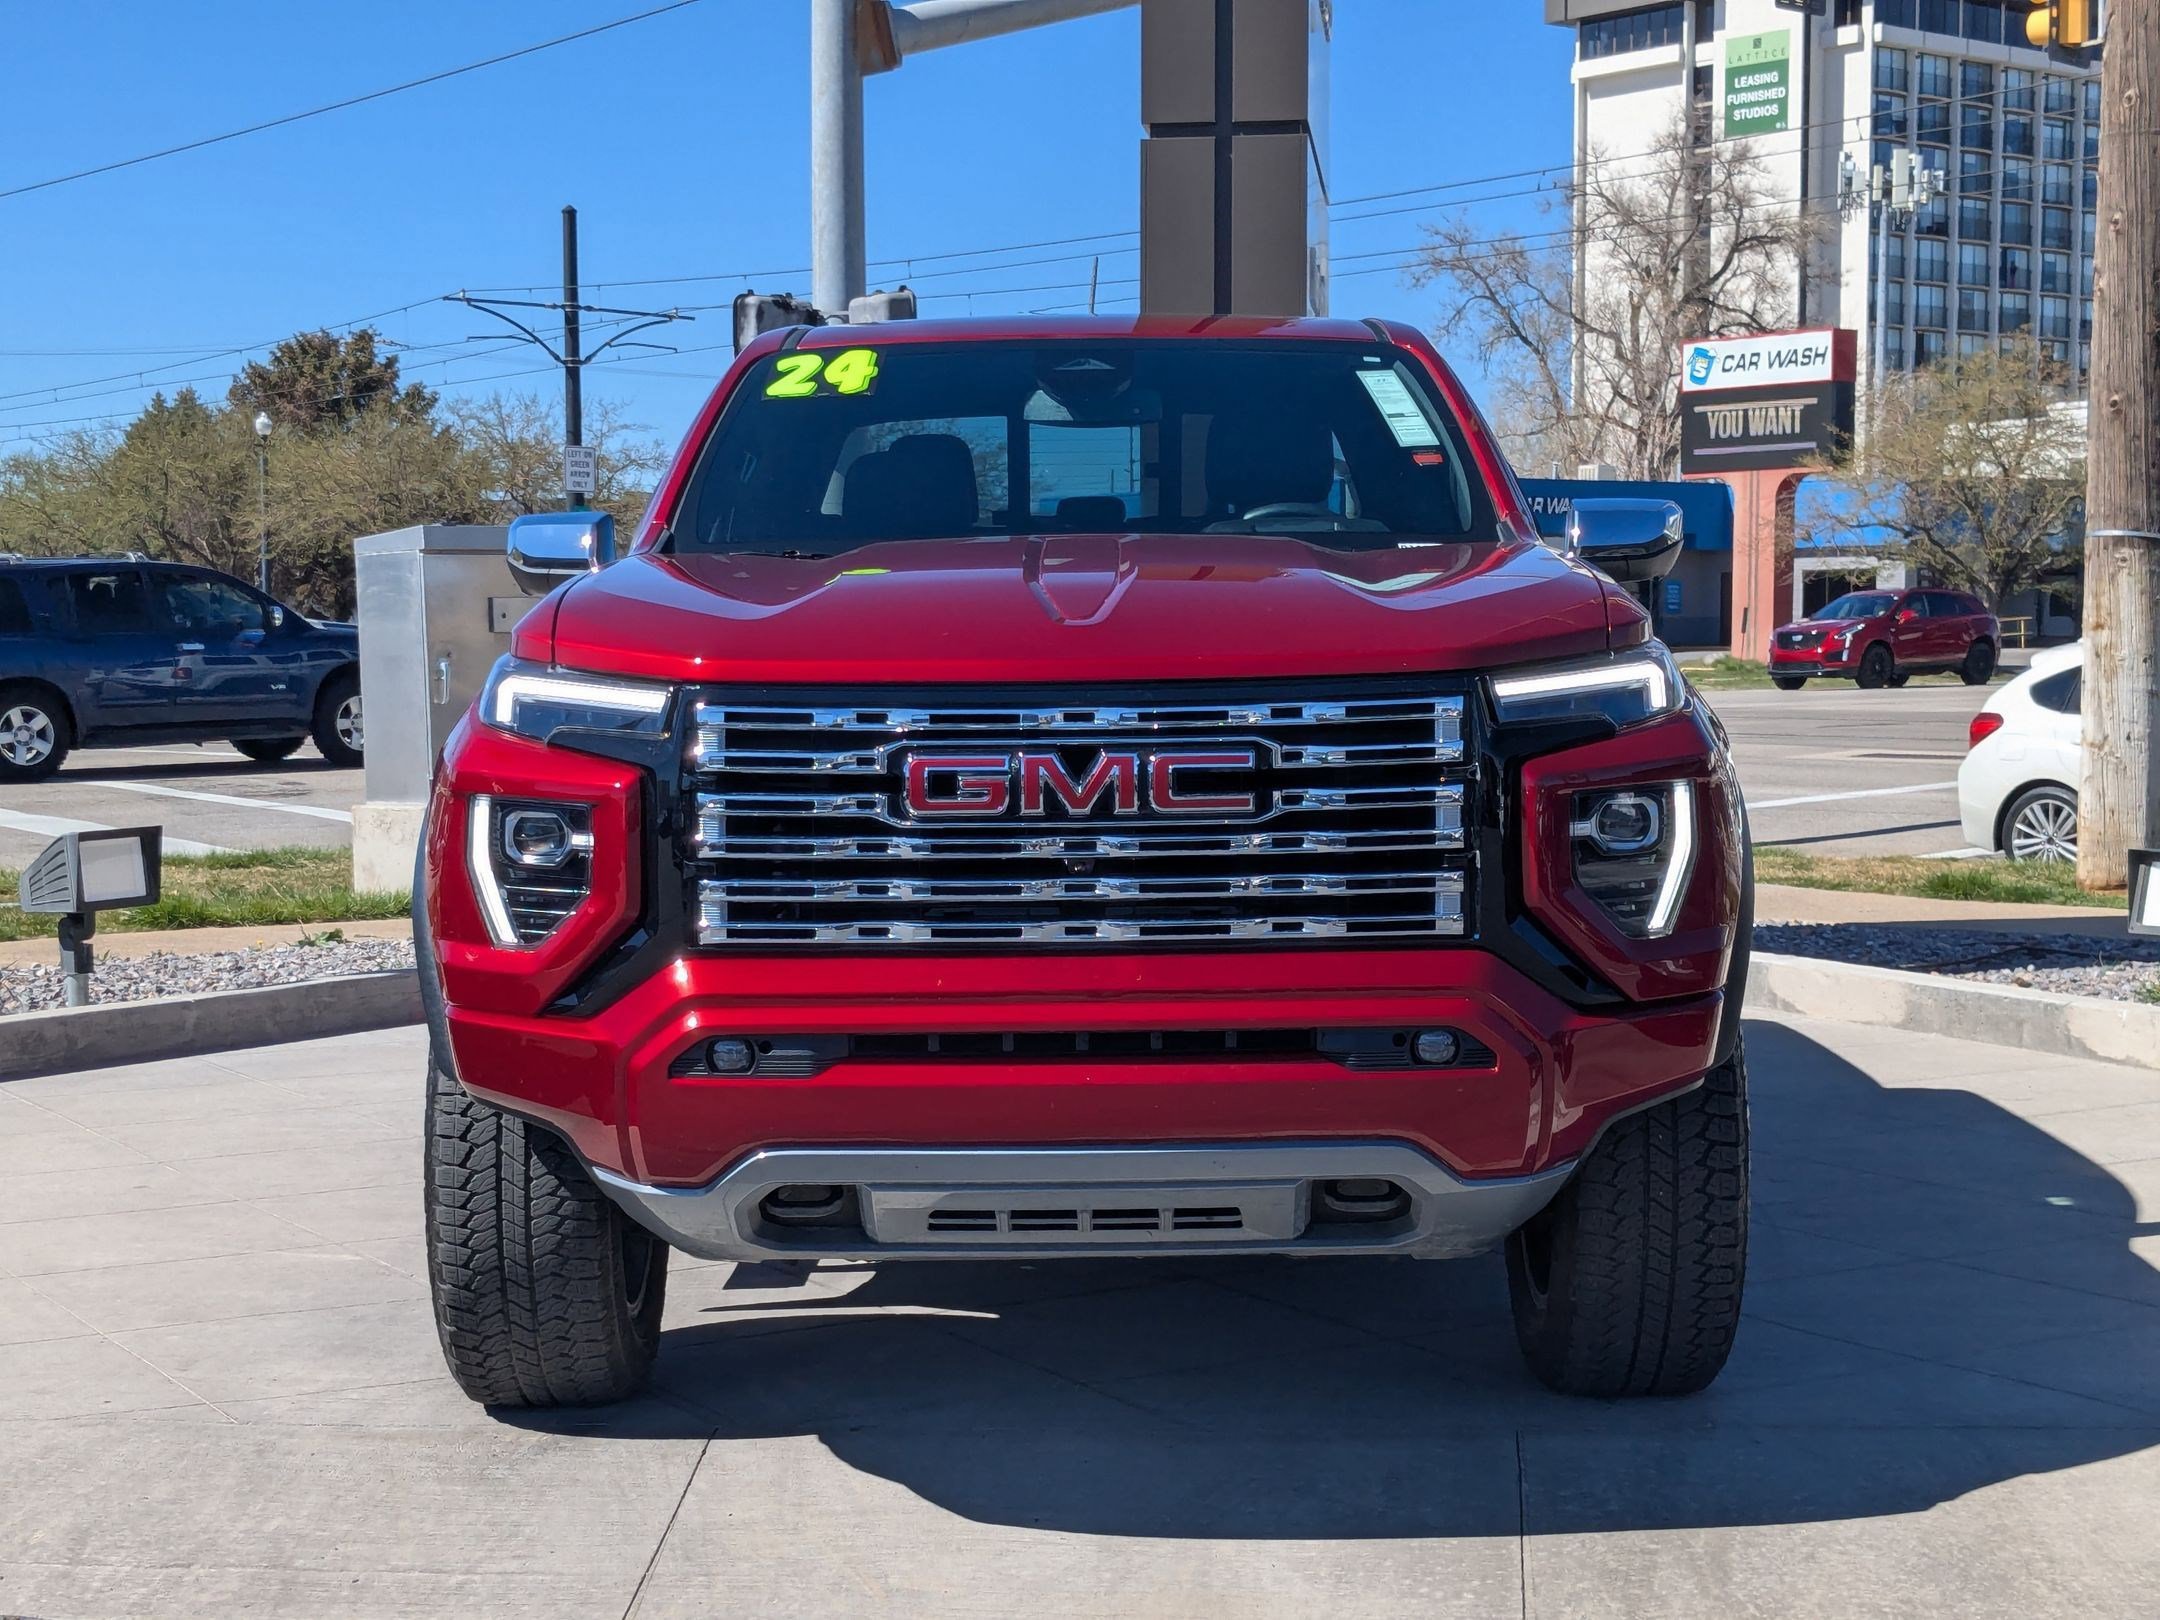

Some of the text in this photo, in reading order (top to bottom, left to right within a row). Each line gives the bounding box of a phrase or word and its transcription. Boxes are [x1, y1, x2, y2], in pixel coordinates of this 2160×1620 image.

[1728, 47, 1786, 64] LATTICE
[1734, 71, 1779, 88] LEASING
[1727, 87, 1786, 106] FURNISHED
[1732, 104, 1779, 121] STUDIOS
[1721, 345, 1829, 373] CAR WASH
[766, 349, 879, 398] 24
[1707, 404, 1805, 440] YOU WANT
[567, 450, 581, 458] LEFT
[570, 460, 590, 469] GREEN
[570, 470, 591, 478] ARROW
[572, 480, 588, 488] ONLY
[903, 750, 1255, 817] GMC
